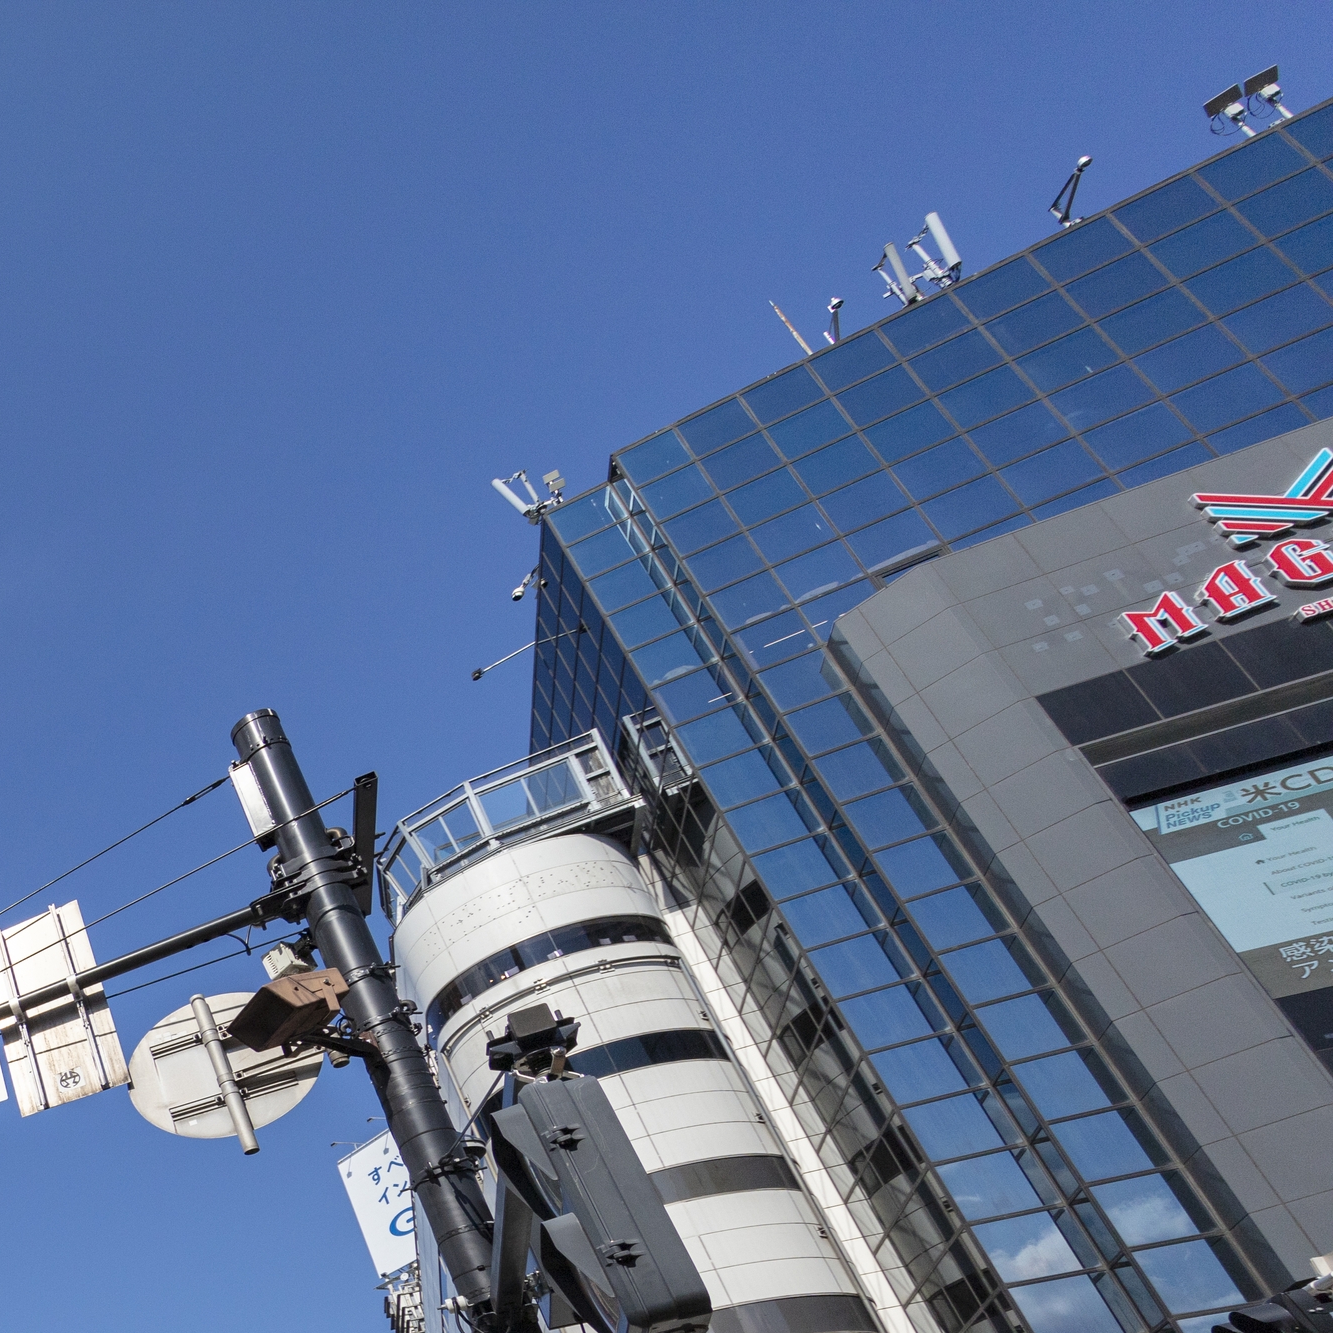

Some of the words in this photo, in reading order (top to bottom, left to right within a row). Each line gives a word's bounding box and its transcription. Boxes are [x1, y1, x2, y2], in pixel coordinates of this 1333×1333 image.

[1121, 538, 1333, 654] MAG
[1163, 796, 1203, 813] NHK
[1165, 802, 1222, 824] Pickup
[1165, 810, 1213, 831] NEWS
[1217, 800, 1301, 830] COVID-19
[1269, 823, 1290, 833] Your
[1291, 815, 1321, 828] Health
[1265, 853, 1287, 863] Your
[1287, 845, 1318, 858] Health
[1271, 865, 1296, 876] About
[1279, 872, 1322, 889] COVID-19
[1289, 886, 1326, 901] Variants
